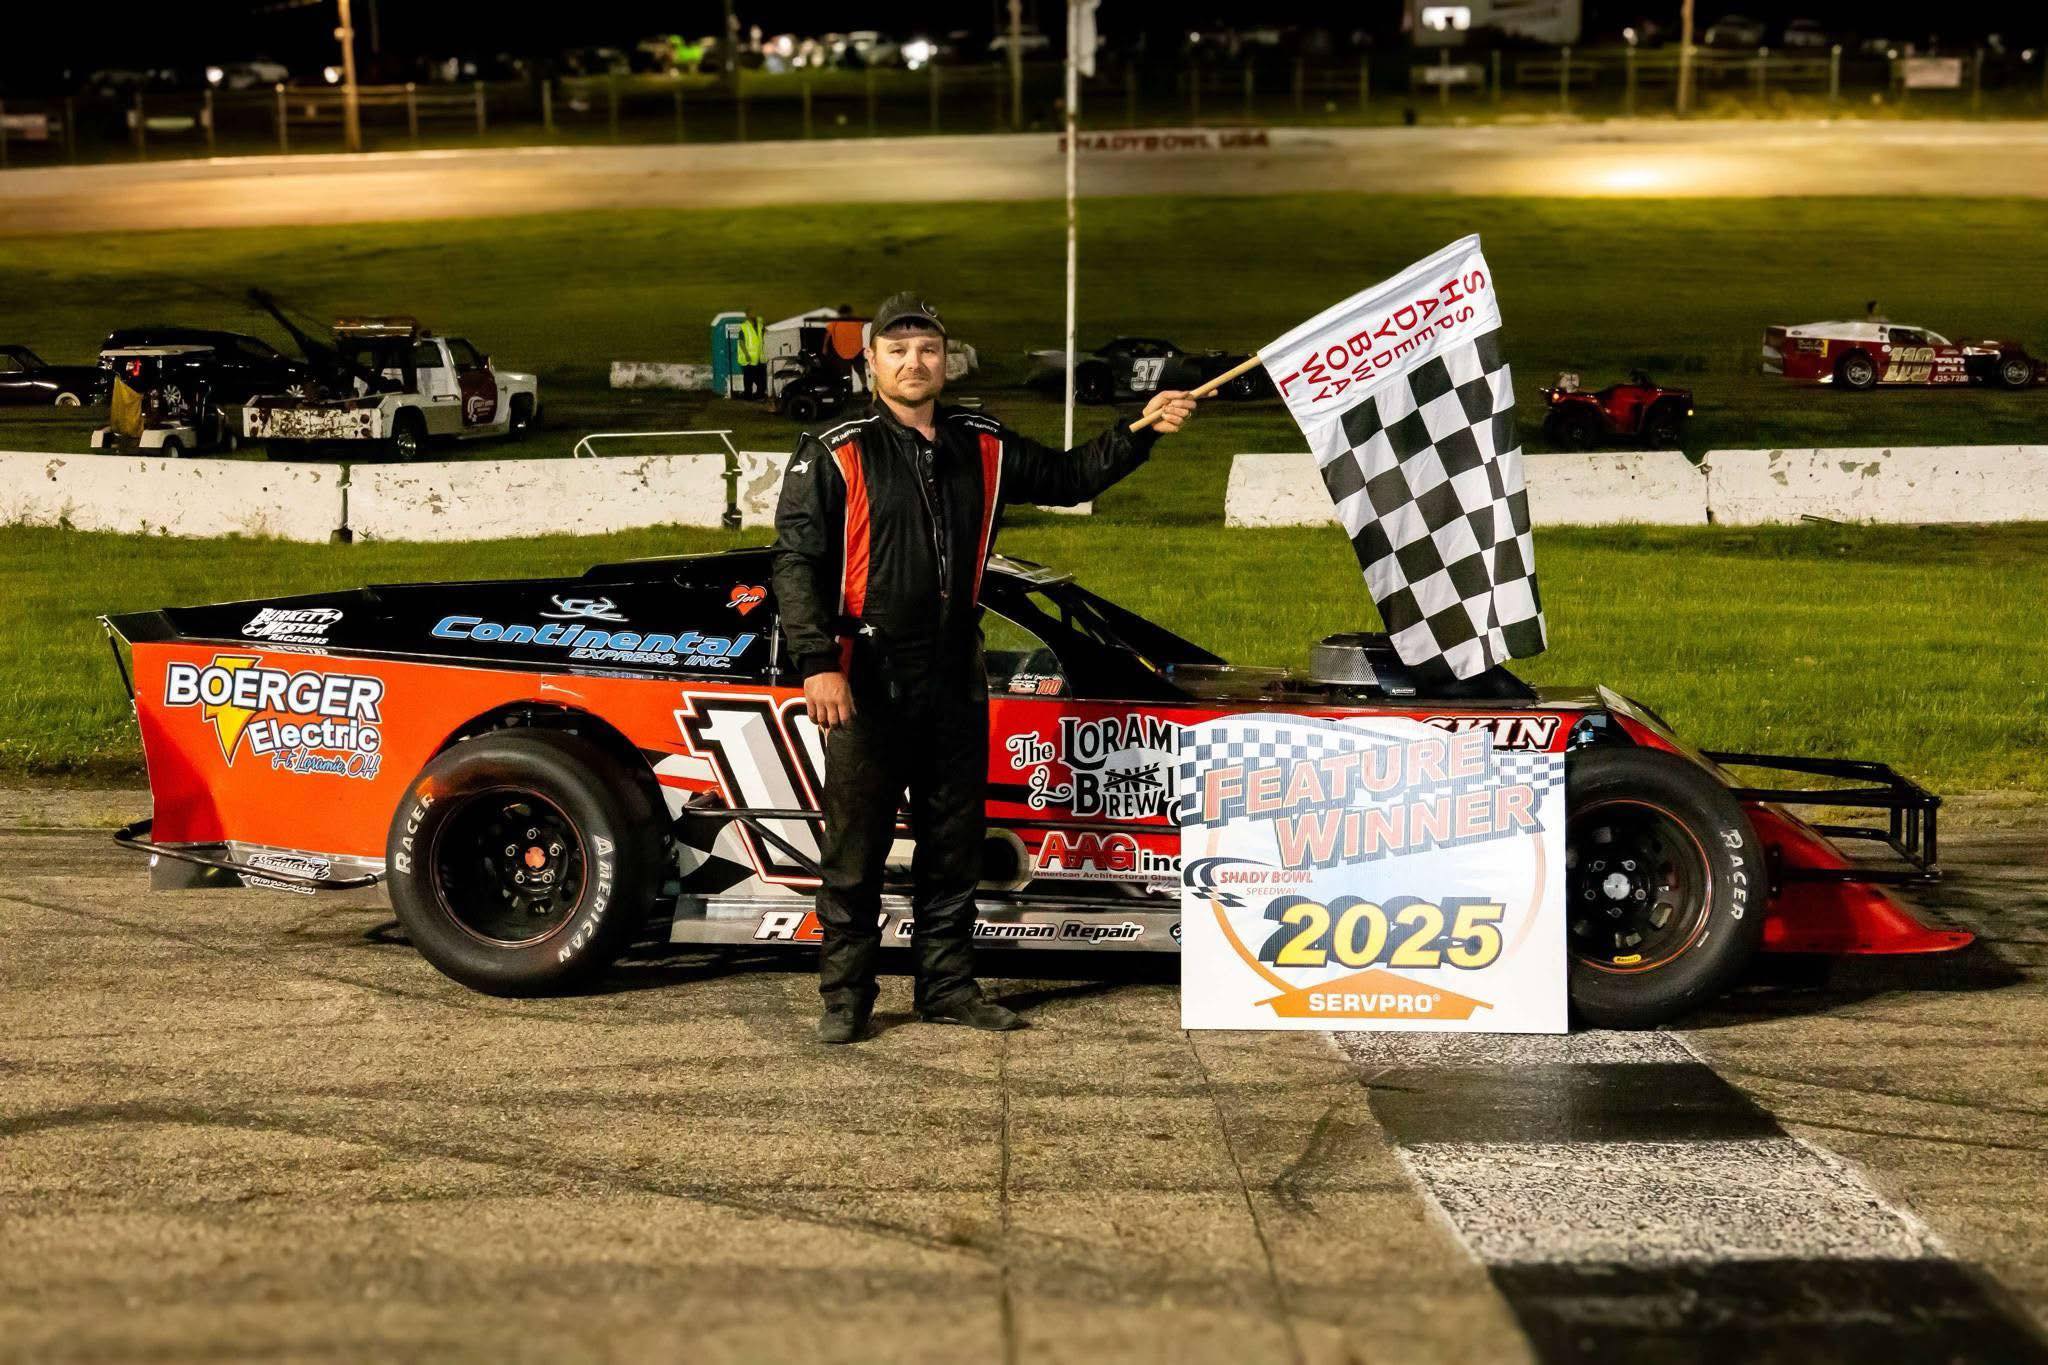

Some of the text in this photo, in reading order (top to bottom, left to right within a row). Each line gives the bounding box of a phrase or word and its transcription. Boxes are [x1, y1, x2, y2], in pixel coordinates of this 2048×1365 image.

[1279, 269, 1486, 398] SHADY BOWL
[1311, 305, 1475, 402] SPEEDWAY
[1131, 357, 1166, 391] 37
[267, 633, 329, 645] RACECARS
[431, 614, 758, 658] Continental
[569, 648, 731, 668] EXPRESS, INC.
[165, 661, 384, 722] BOERGER
[247, 716, 381, 755] Electric
[1007, 731, 1055, 769] The
[1202, 730, 1489, 826] FEATURE
[394, 792, 436, 876] RACER
[1275, 782, 1541, 870] WINNER
[1033, 870, 1081, 878] American
[1082, 871, 1148, 881] Architectural
[1220, 870, 1314, 884] SHADY BOWL
[1246, 887, 1298, 896] SPEEDWAY
[1719, 828, 1748, 921] RACER
[557, 833, 615, 964] AMERICAN
[1062, 921, 1143, 942] Repair
[1267, 896, 1508, 971] 2025
